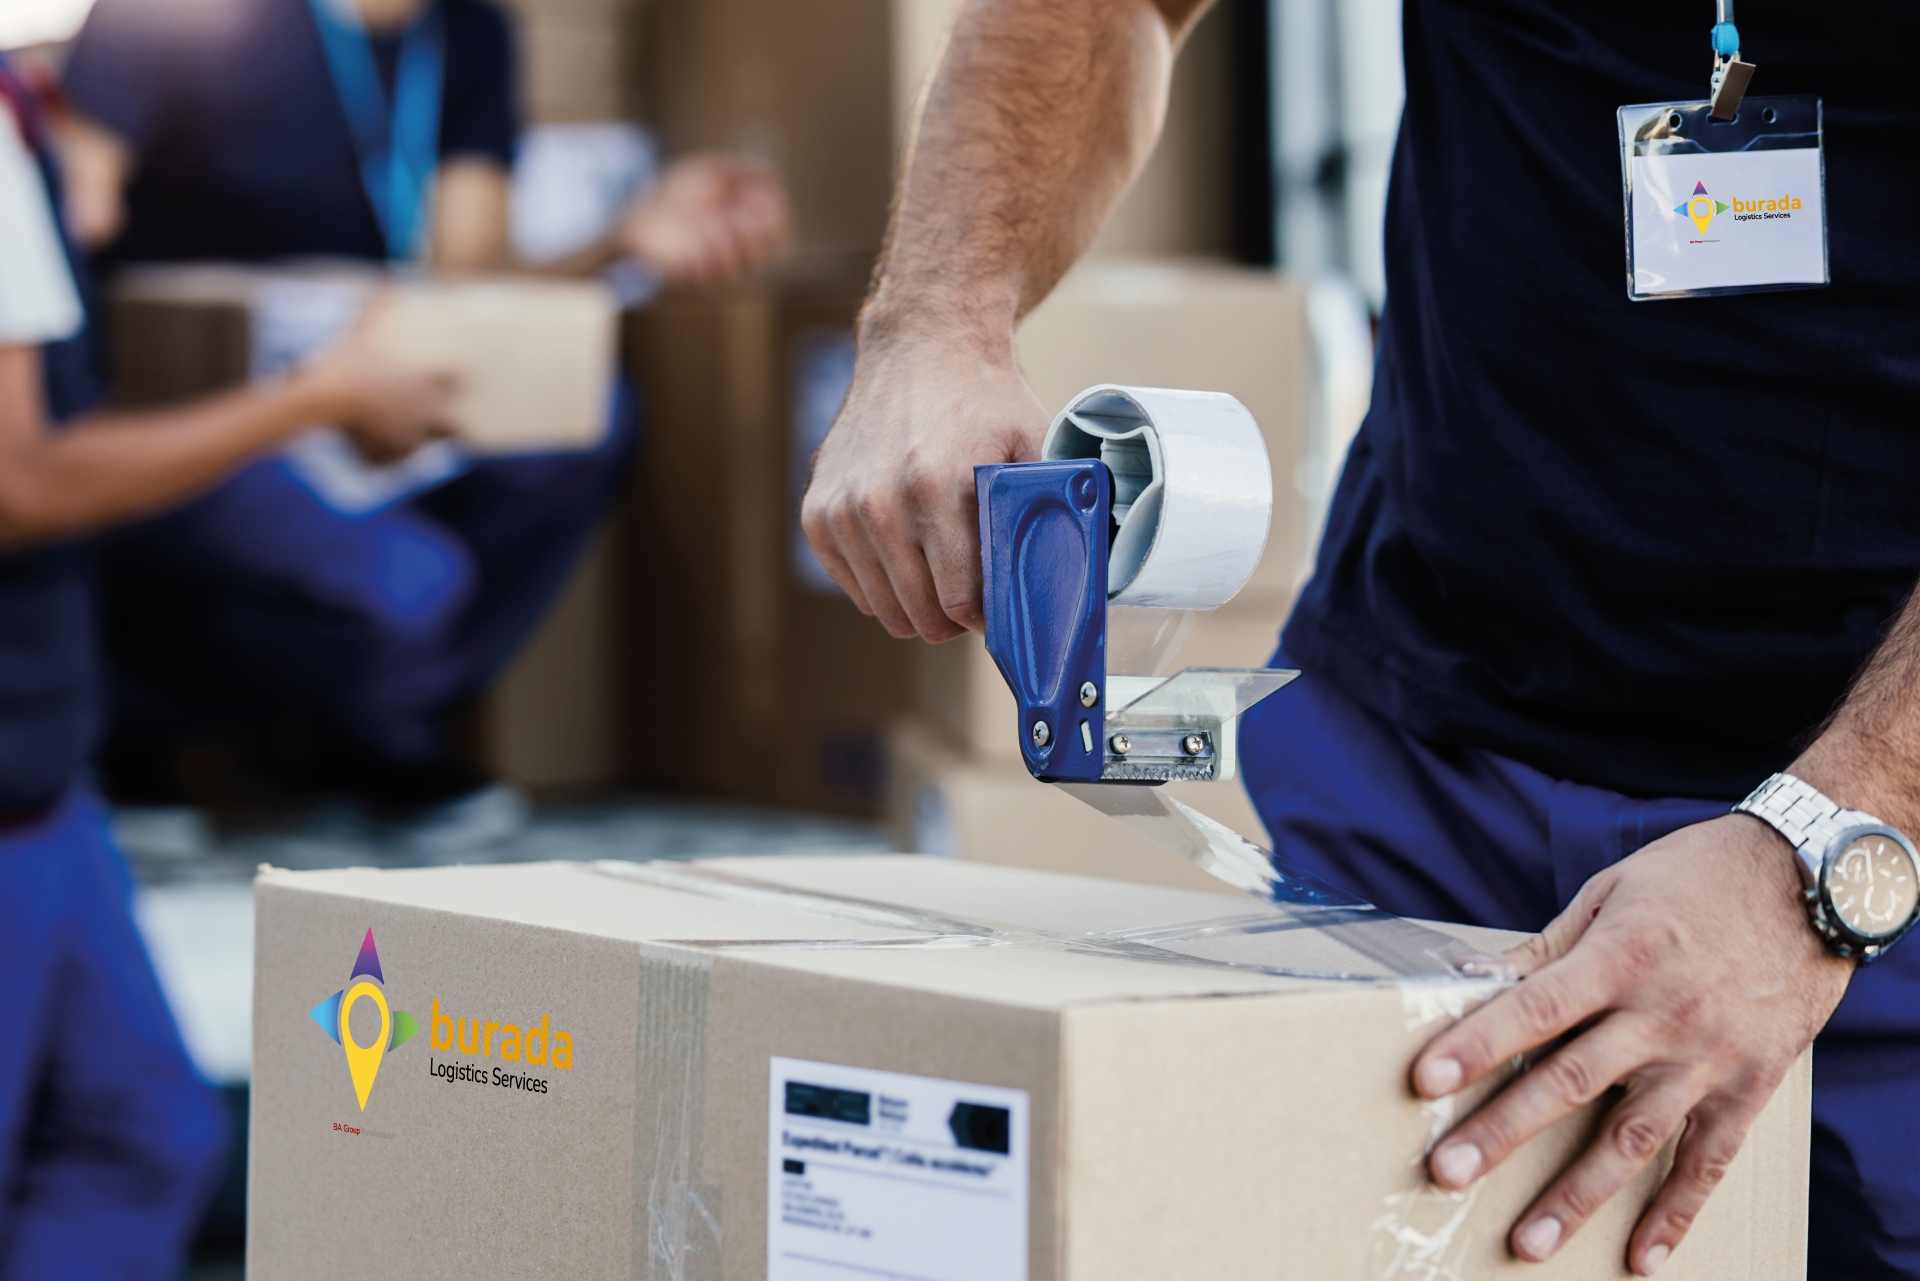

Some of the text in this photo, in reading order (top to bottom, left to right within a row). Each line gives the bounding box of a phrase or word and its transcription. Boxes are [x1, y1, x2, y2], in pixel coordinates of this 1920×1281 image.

[1732, 194, 1802, 213] burada
[1734, 212, 1791, 221] Logistics Services
[431, 998, 573, 1070] burada
[430, 1057, 548, 1094] Logistics Services
[333, 1122, 342, 1132] BA
[343, 1124, 361, 1136] Group
